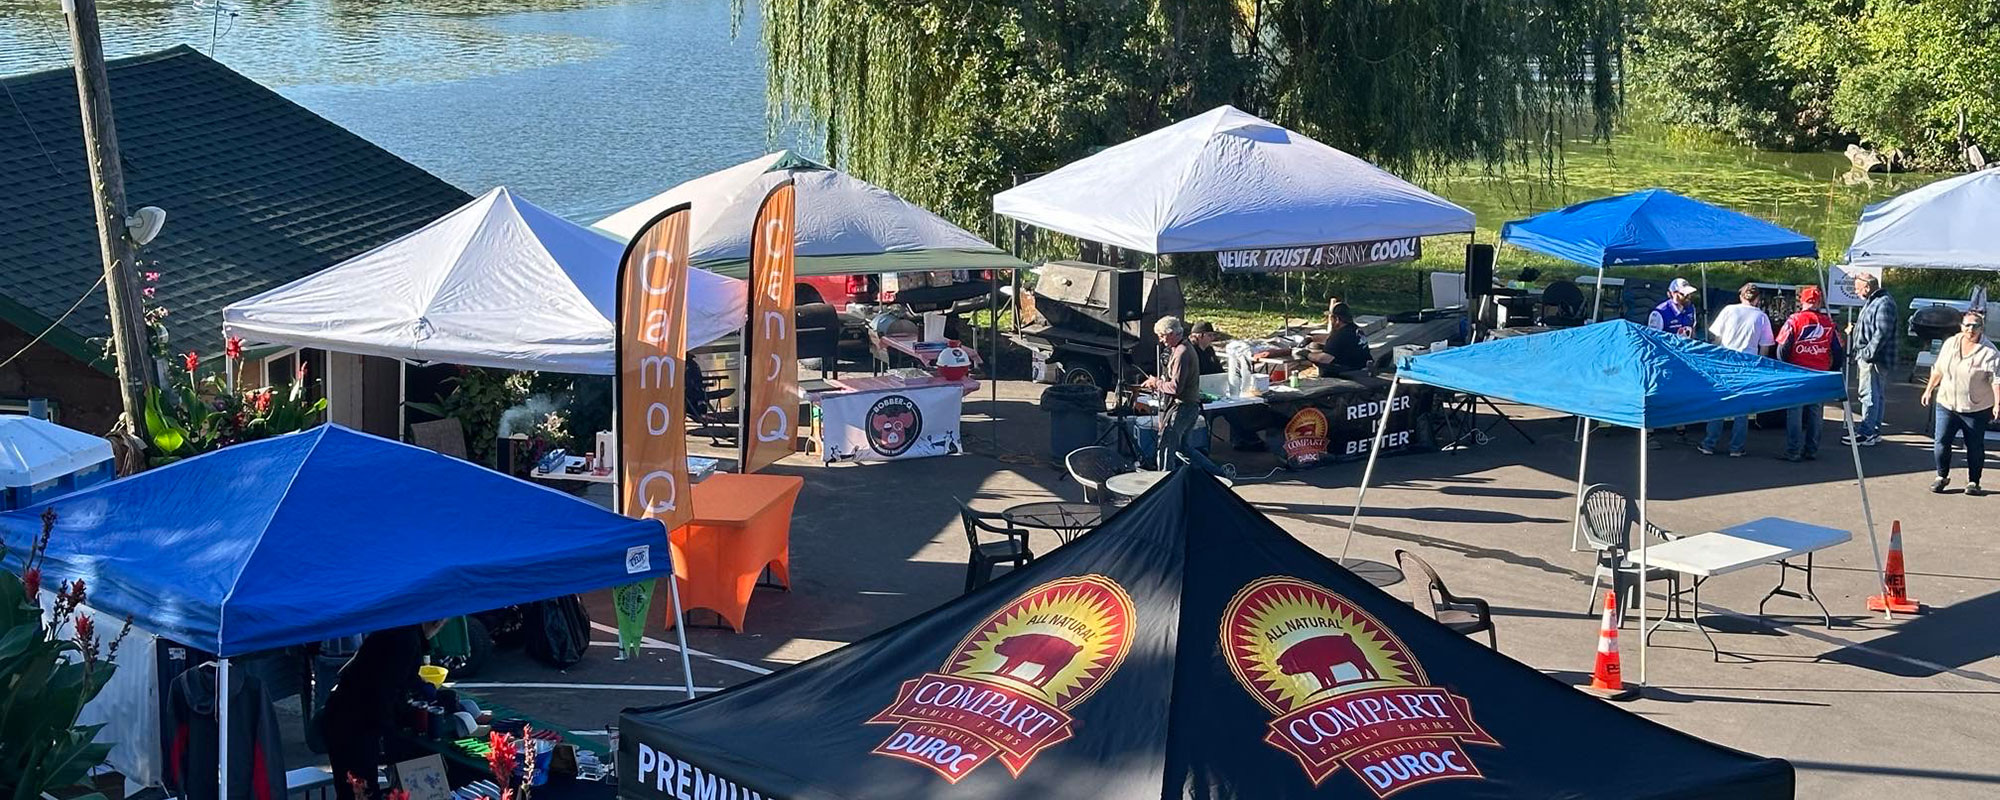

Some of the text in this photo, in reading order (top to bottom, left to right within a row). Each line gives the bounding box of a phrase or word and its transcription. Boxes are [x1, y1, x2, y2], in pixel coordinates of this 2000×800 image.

[1217, 237, 1417, 268] NEVER TRUST A SKINNY COOK!
[1026, 614, 1096, 642] ALL NATURAL
[1265, 616, 1343, 643] ALL NATURAL
[910, 707, 1022, 746] FAMILY FARMS
[915, 681, 1058, 738] COMPART
[1289, 694, 1451, 745] COMPART
[886, 732, 978, 773] DUROC
[917, 725, 983, 751] PREMIUM
[1319, 721, 1455, 755] FAMILY FARMS
[1362, 741, 1440, 762] PREMIUM
[1363, 750, 1468, 789] DUROC
